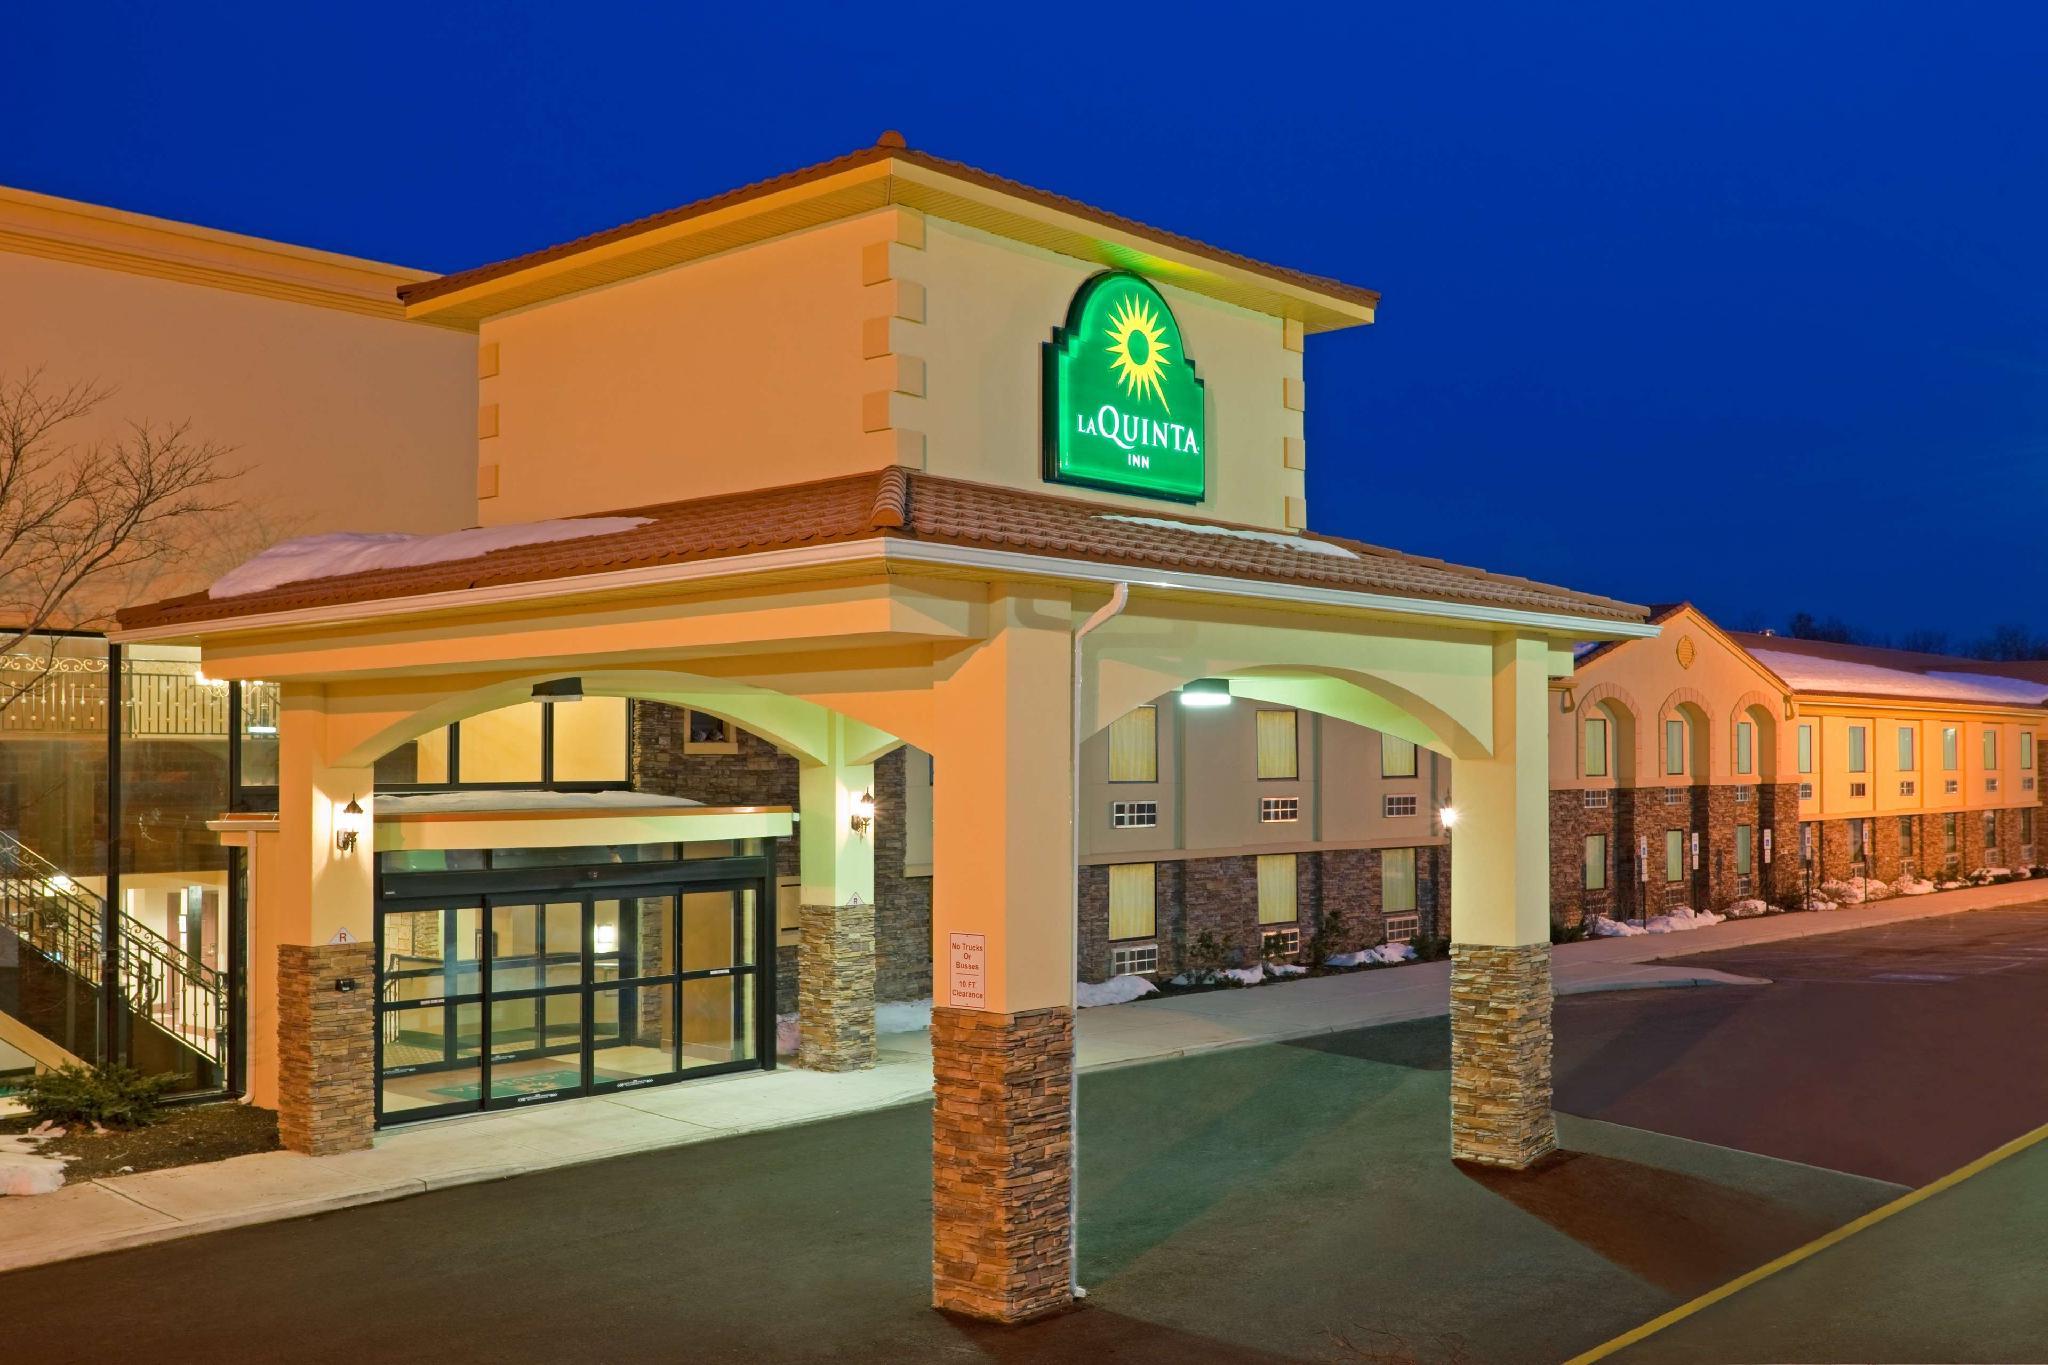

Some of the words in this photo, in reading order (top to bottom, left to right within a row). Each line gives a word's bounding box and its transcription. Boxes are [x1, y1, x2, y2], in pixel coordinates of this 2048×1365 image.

[1128, 454, 1150, 469] INN
[340, 933, 346, 942] R
[956, 962, 979, 970] Busses
[952, 989, 983, 999] Clearance
